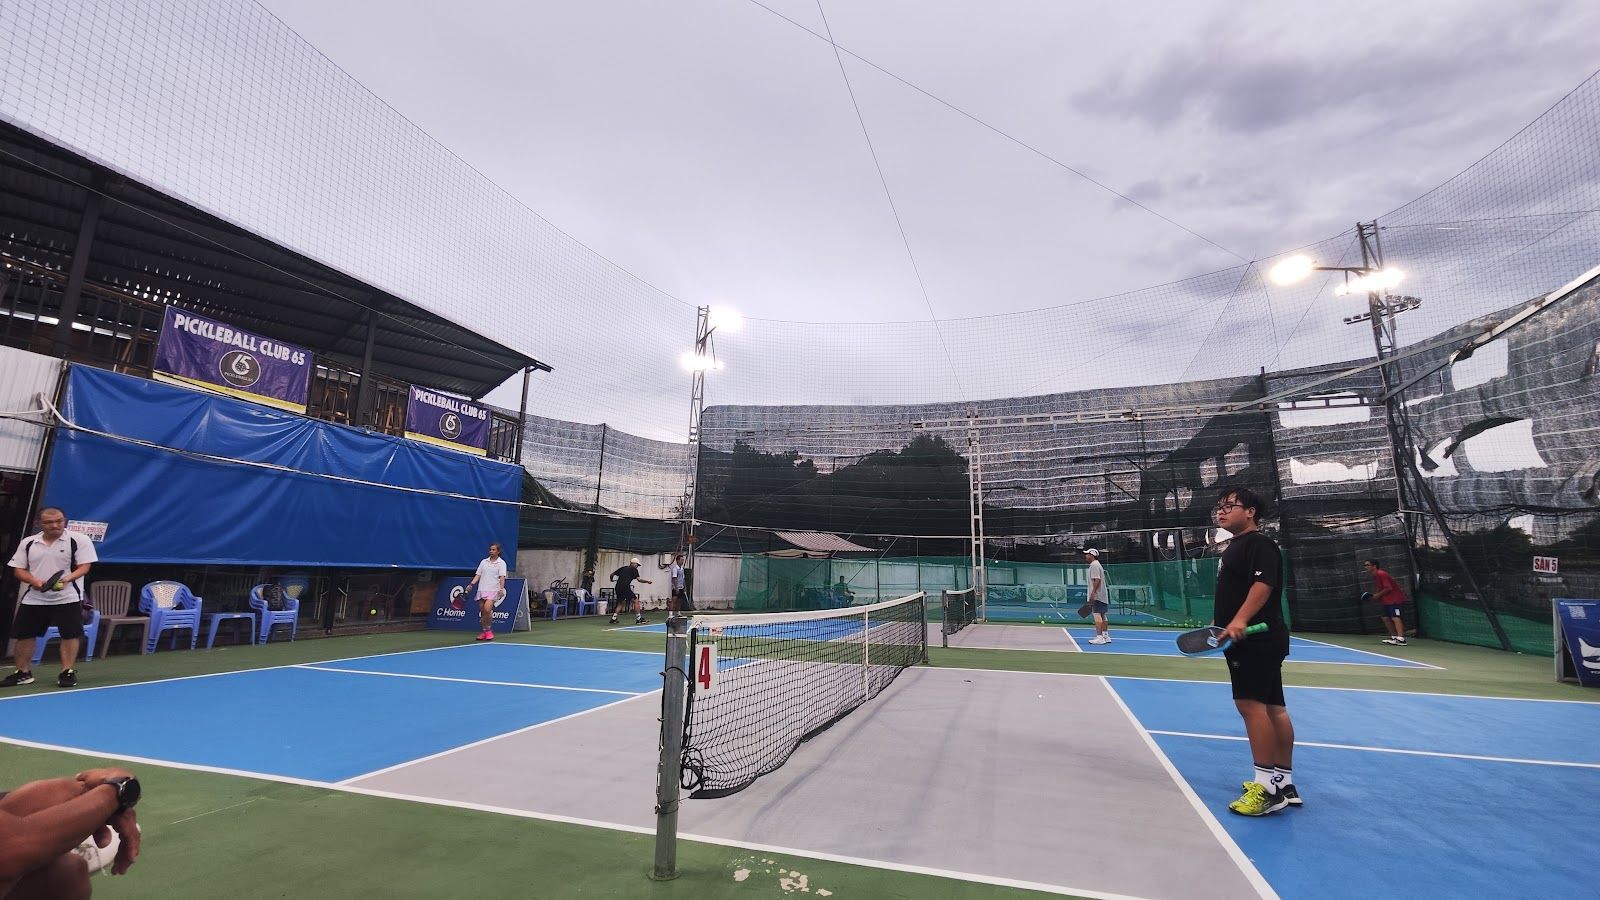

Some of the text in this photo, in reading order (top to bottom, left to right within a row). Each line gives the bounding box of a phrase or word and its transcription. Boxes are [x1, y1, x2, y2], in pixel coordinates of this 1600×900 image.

[174, 313, 305, 366] PICKLEBALL CLUB 65
[415, 389, 487, 421] PICKLEBALL CLUB 65
[1551, 559, 1557, 572] 5
[436, 607, 466, 617] C Home
[490, 610, 509, 619] ome
[698, 646, 711, 690] 4
